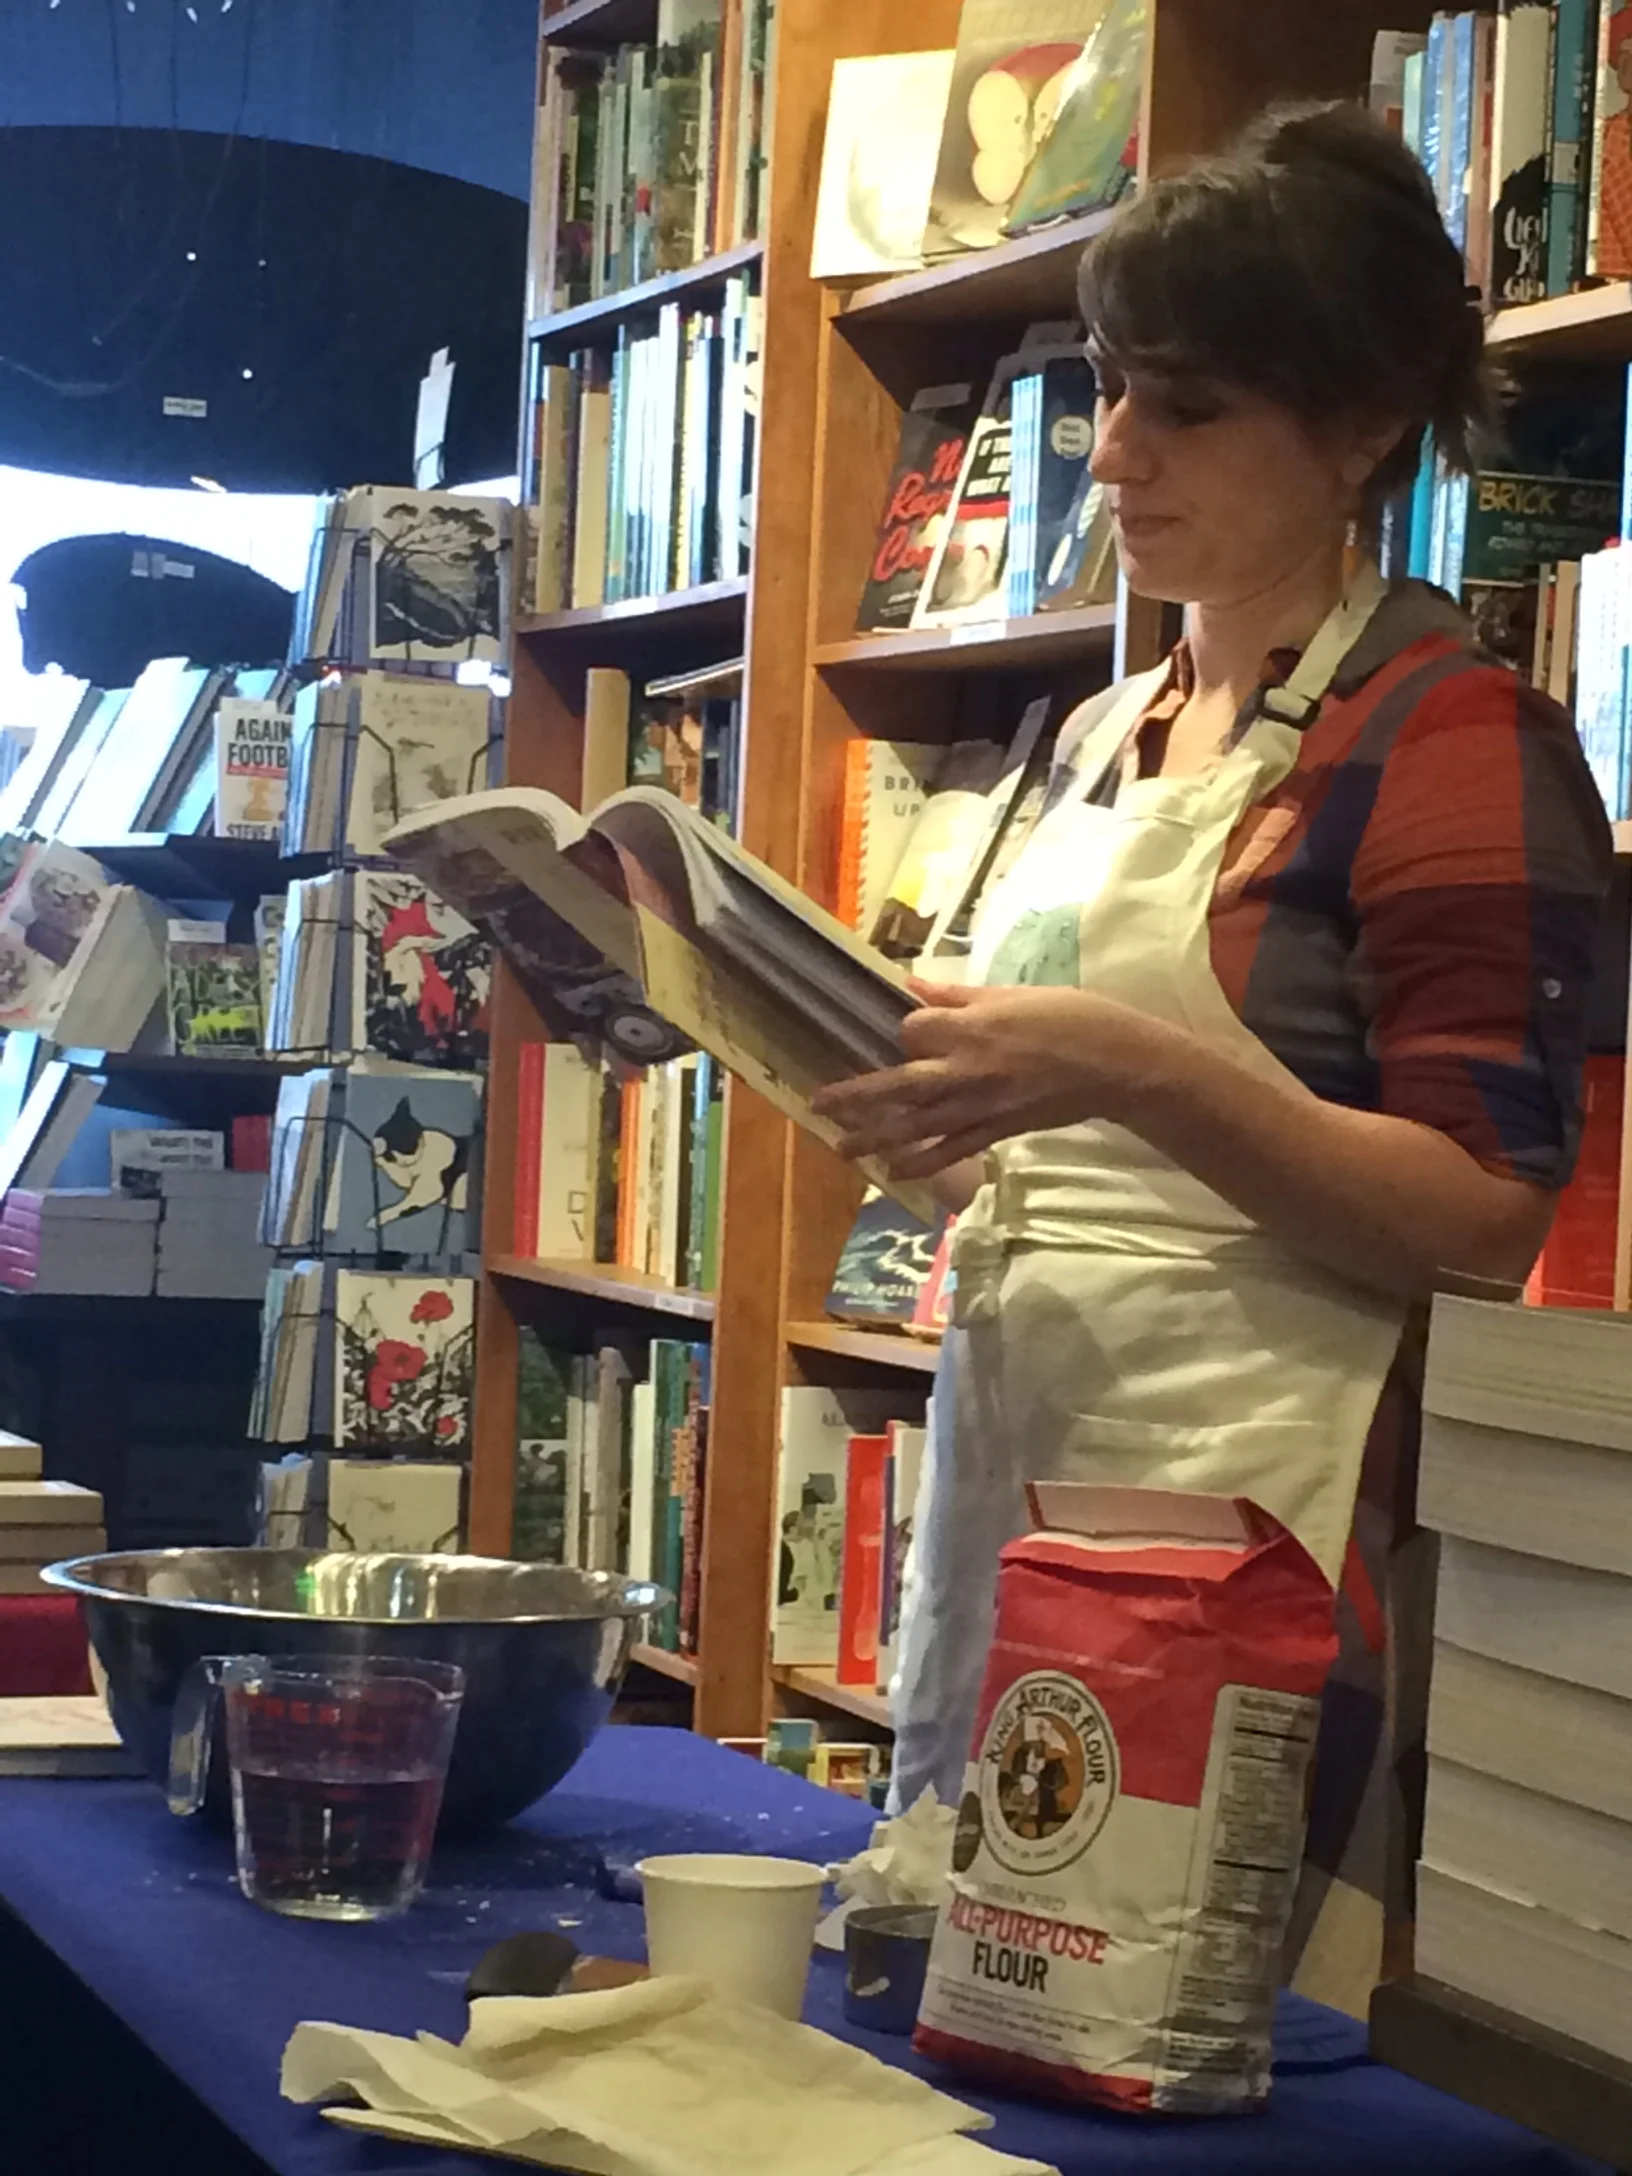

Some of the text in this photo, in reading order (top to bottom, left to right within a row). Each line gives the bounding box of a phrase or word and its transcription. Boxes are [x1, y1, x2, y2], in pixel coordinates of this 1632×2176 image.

[1478, 480, 1558, 516] BRICK
[235, 717, 292, 742] AGAIN
[227, 743, 288, 768] FOOTB
[1015, 1687, 1082, 1723] ARTHUR
[1075, 1713, 1106, 1788] FLOUR
[971, 1940, 1050, 1993] FLOUR
